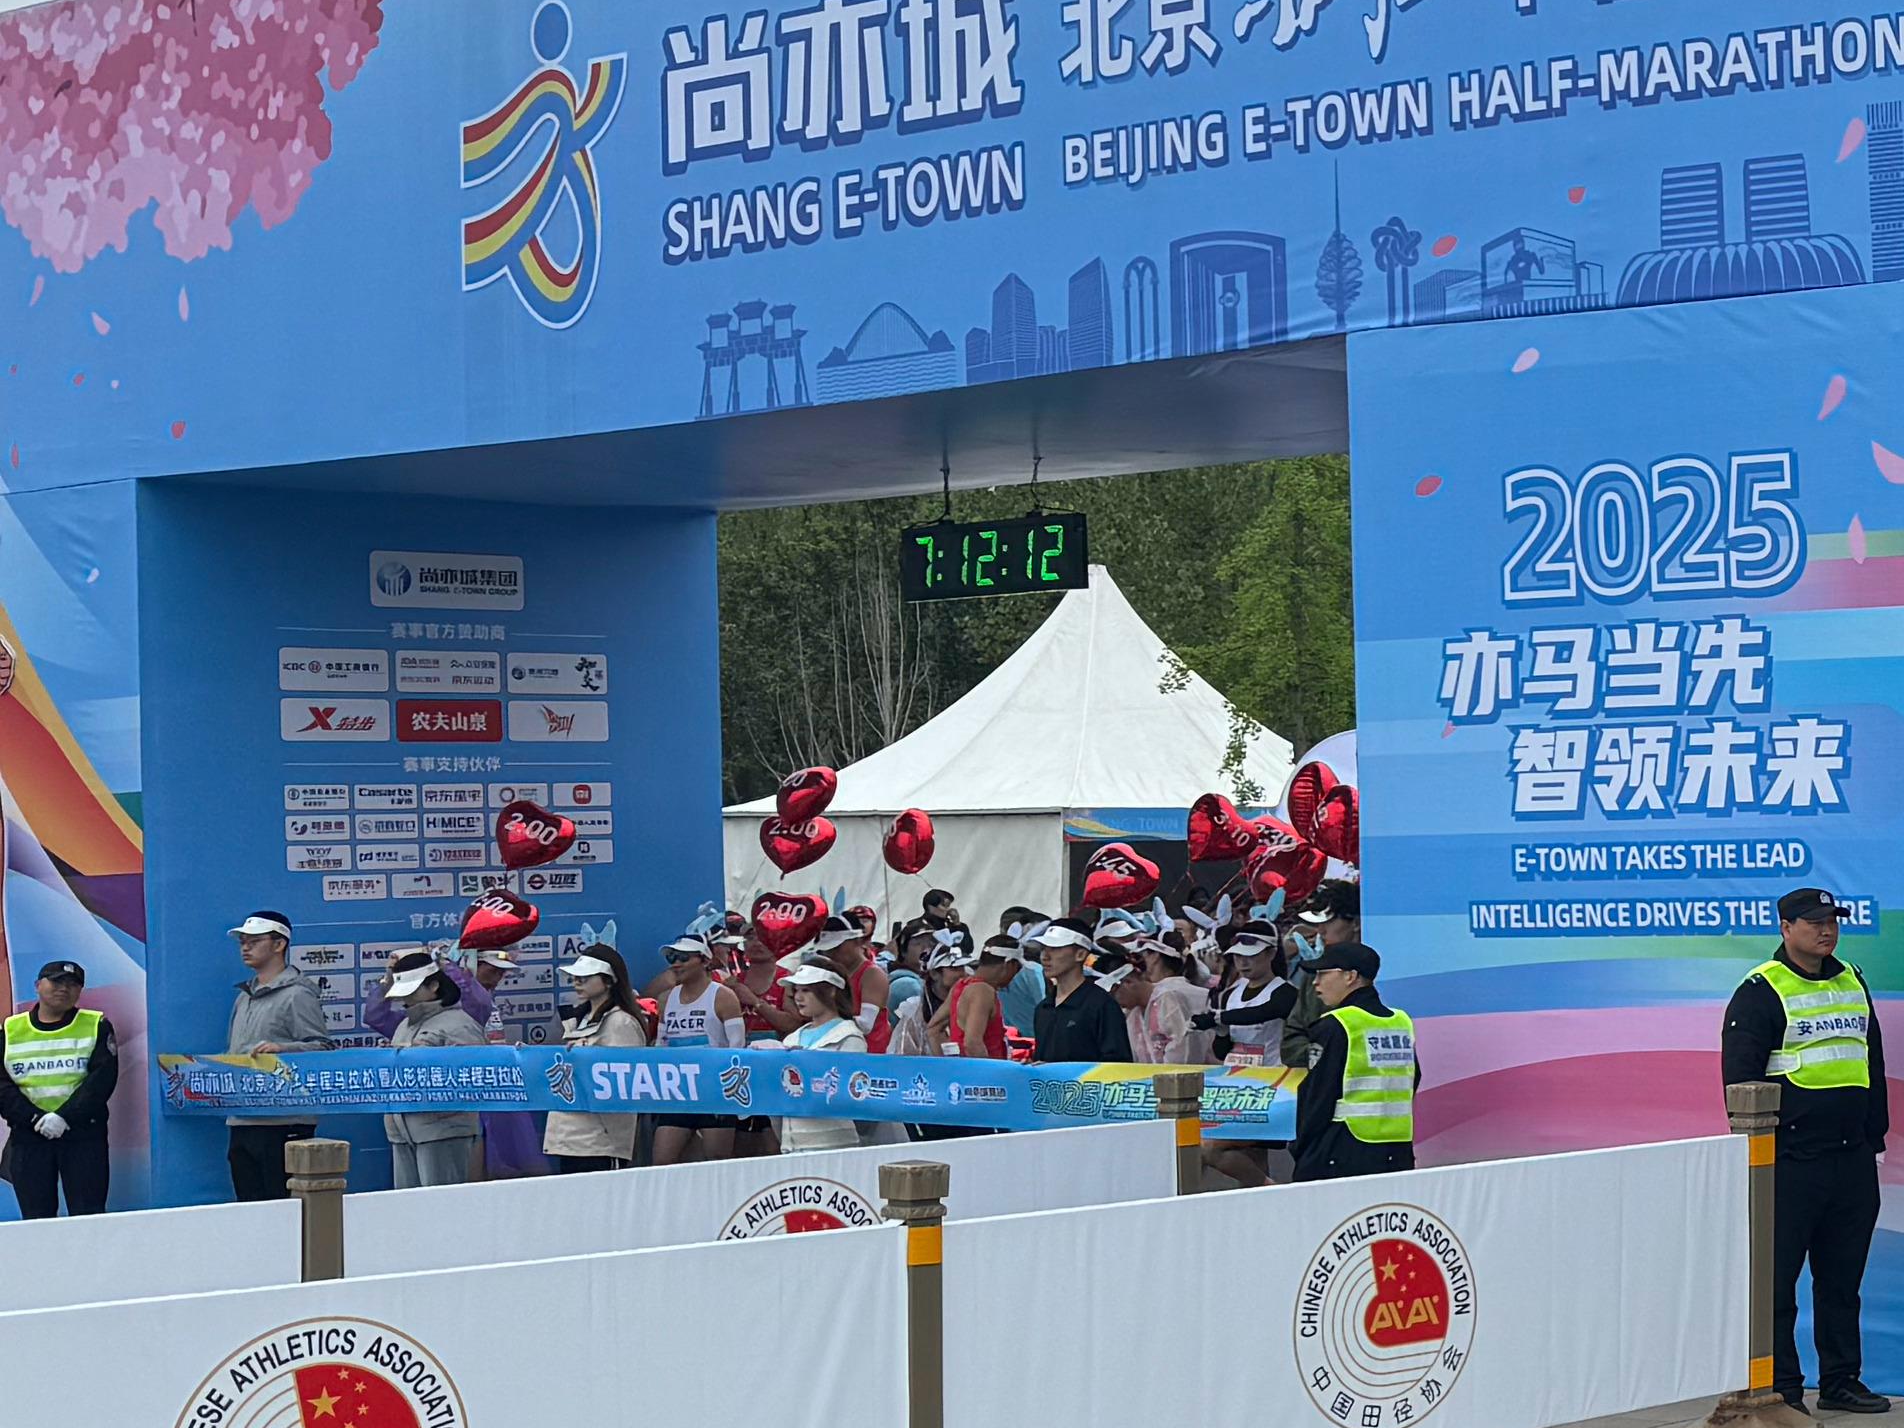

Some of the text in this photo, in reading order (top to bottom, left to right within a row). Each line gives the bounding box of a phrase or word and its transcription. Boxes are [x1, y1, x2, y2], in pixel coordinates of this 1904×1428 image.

[665, 178, 821, 262] SHANG
[834, 147, 1025, 235] E-TOWN
[1062, 112, 1228, 185] BEIJING
[1244, 82, 1428, 160] E-TOWN
[1504, 452, 1800, 601] 2025
[916, 525, 1064, 588] 7:12:12
[1440, 616, 1770, 717] 亦马当先
[412, 711, 487, 732] 农夫山泉
[1512, 718, 1845, 815] 智领未来
[504, 813, 558, 846] 2:00
[1514, 841, 1805, 873] E-TOWN TAKES THE LEAD
[759, 901, 808, 923] 2:00
[1471, 899, 1771, 930] INTELLIGENCE DRIVES THE
[667, 1018, 704, 1031] PACER
[1816, 1018, 1858, 1031] ANBAO
[27, 1059, 74, 1071] ANBAO
[593, 1062, 701, 1101] START
[1030, 1080, 1100, 1118] 2025
[744, 1185, 823, 1229] ATHLETICS
[1301, 1212, 1471, 1338] CHINESE ATHLETICS ASSOCIATION
[229, 1328, 357, 1393] ATHLETICS
[1311, 1344, 1464, 1428] 中国田径协会
